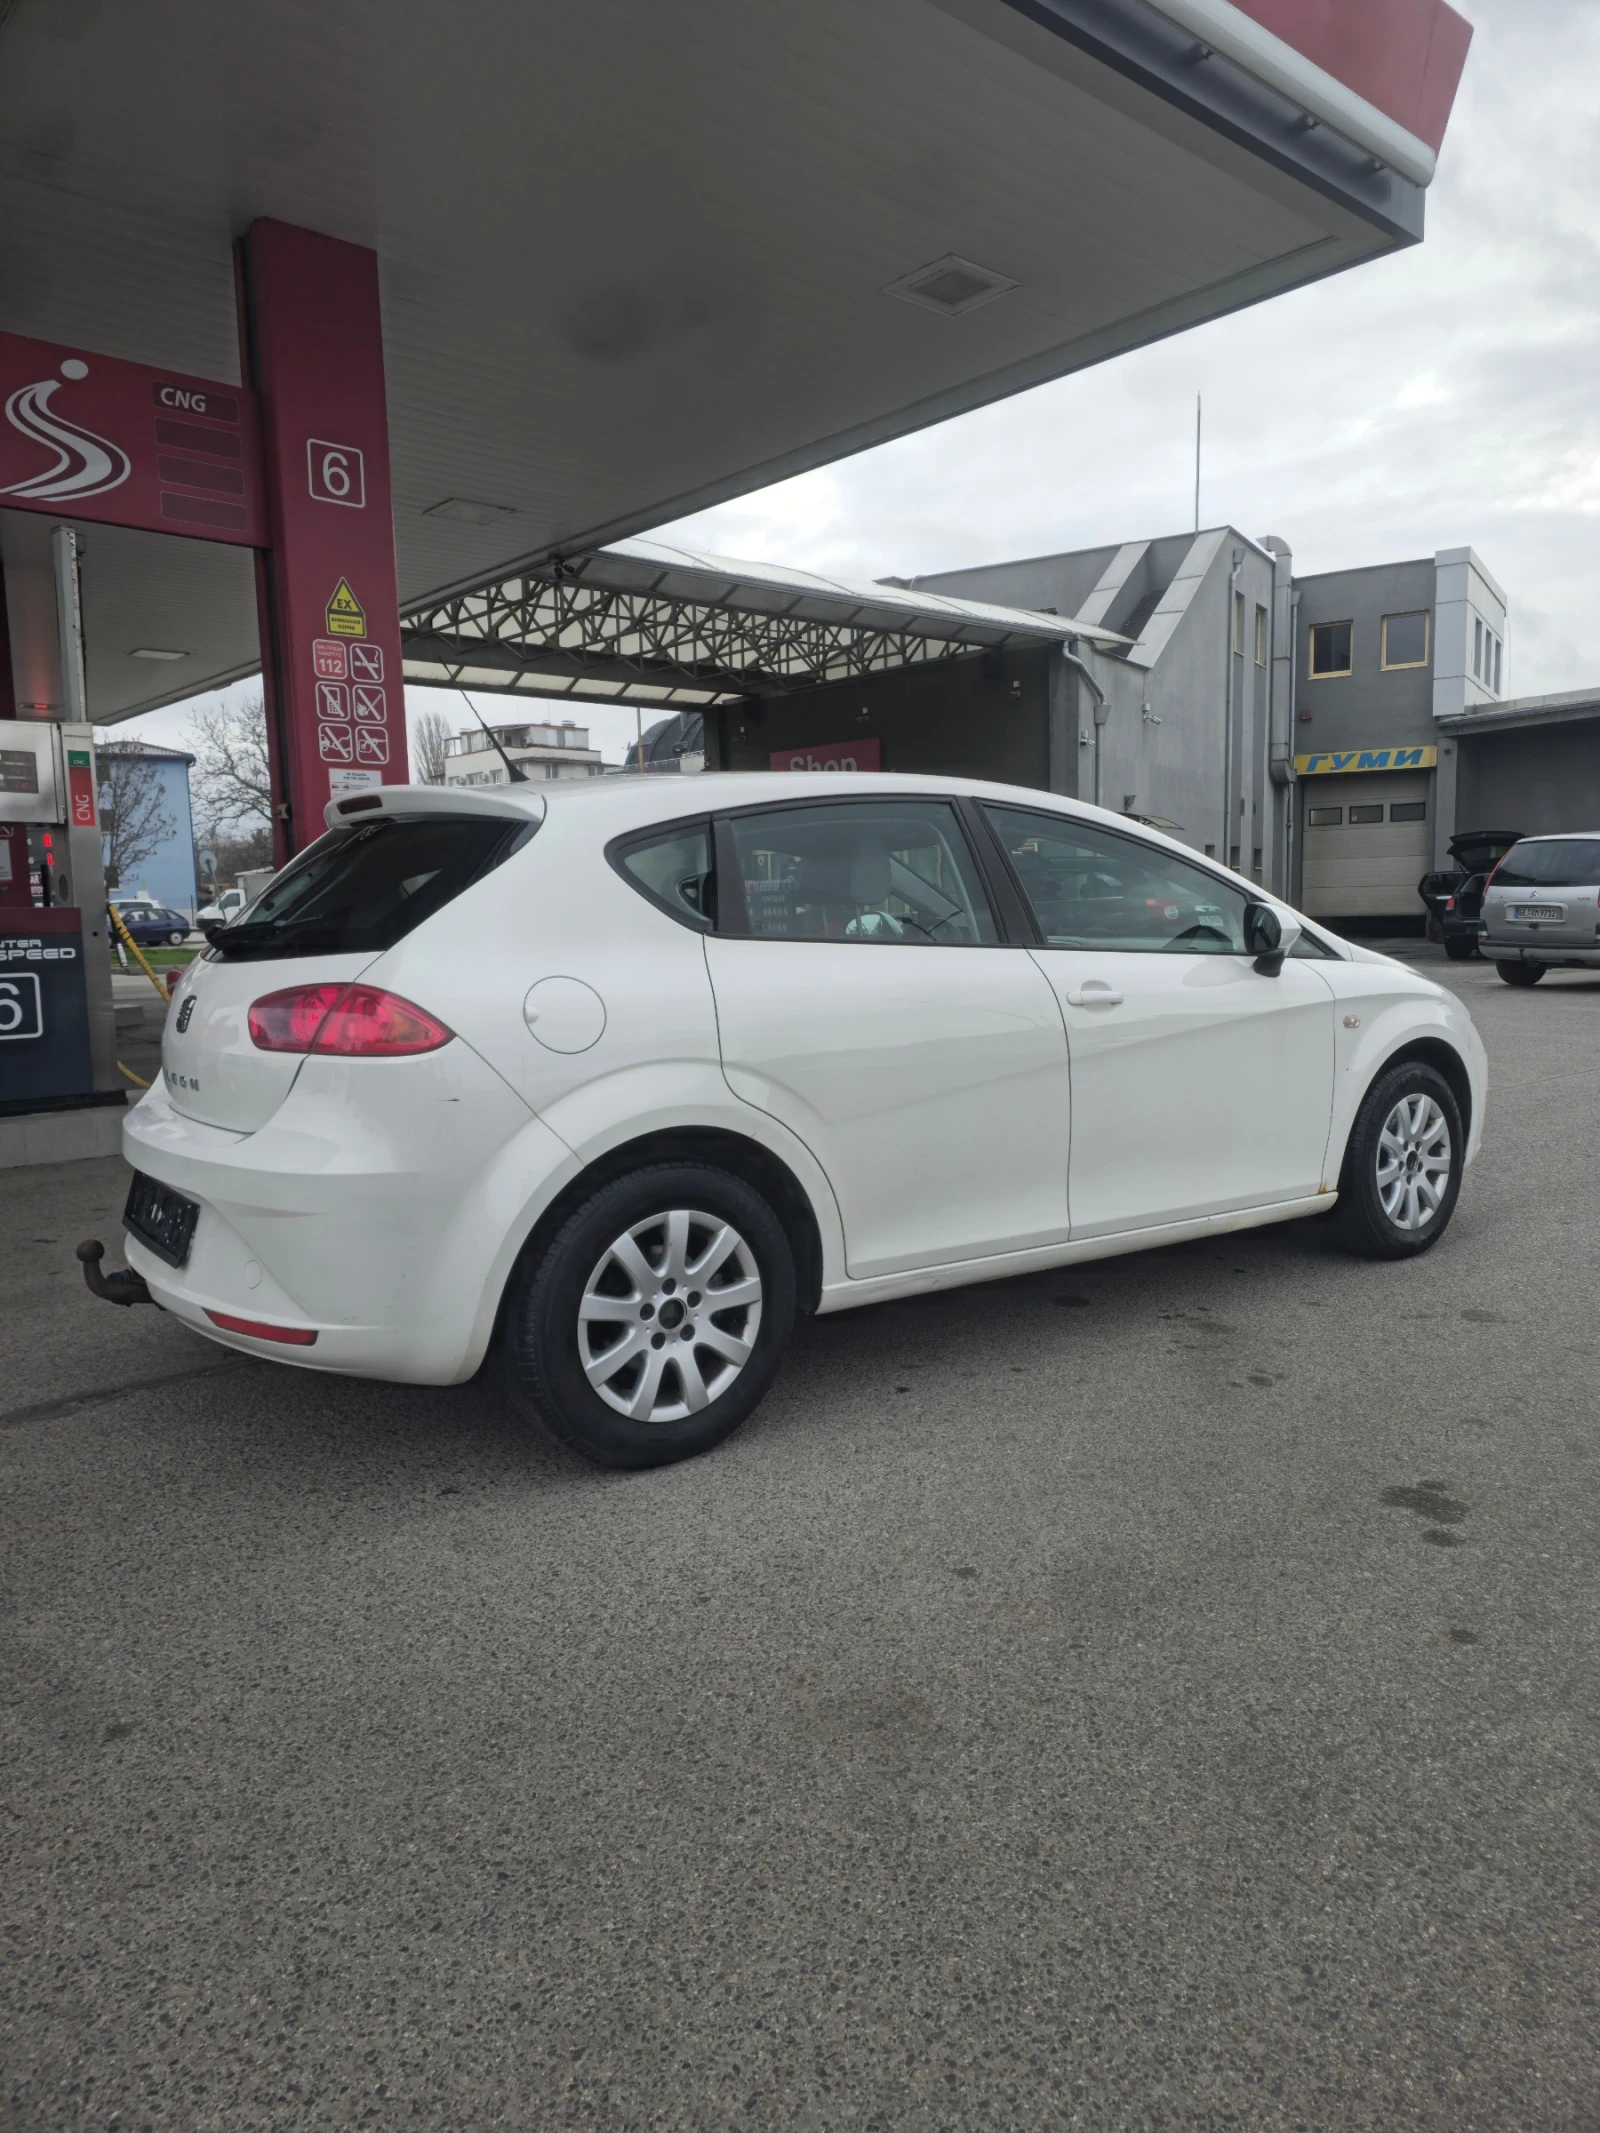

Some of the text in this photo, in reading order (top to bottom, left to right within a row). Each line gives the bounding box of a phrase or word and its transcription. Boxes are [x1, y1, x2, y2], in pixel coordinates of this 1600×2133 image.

[160, 387, 207, 413] CNG
[322, 451, 350, 496] 6
[336, 598, 352, 610] EX
[319, 658, 343, 673] 112
[789, 755, 858, 772] Shop
[1306, 748, 1424, 772] ГУМИ
[75, 794, 91, 821] CNG
[1540, 909, 1557, 918] 9712
